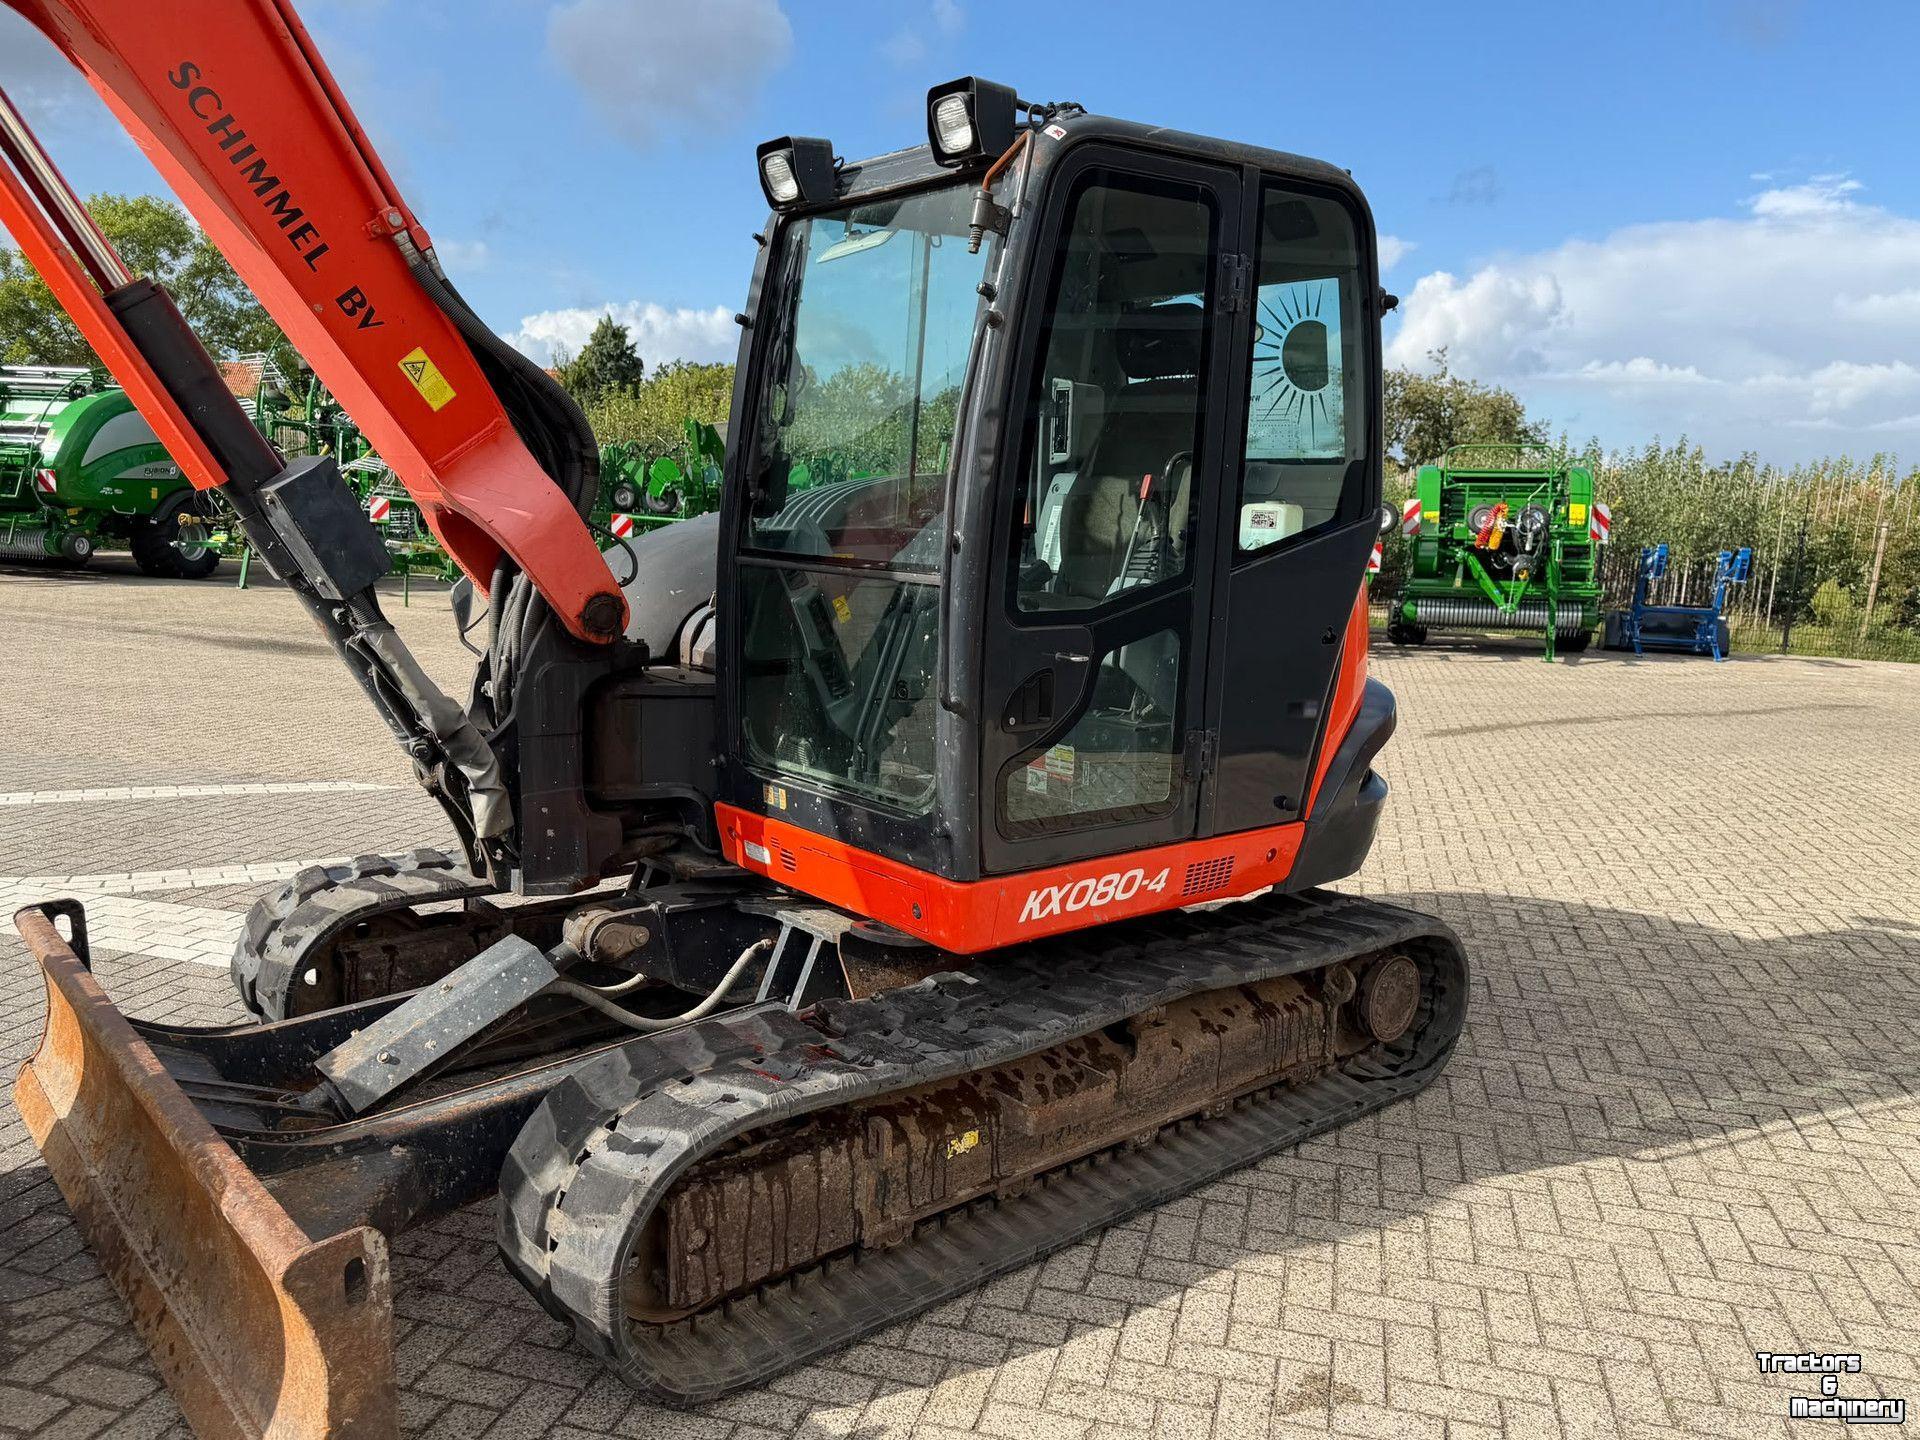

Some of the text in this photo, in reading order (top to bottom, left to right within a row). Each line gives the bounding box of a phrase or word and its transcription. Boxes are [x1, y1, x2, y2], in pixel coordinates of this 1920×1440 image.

[168, 61, 385, 331] SCHIMMEL BV
[1018, 868, 1171, 923] KX080-4
